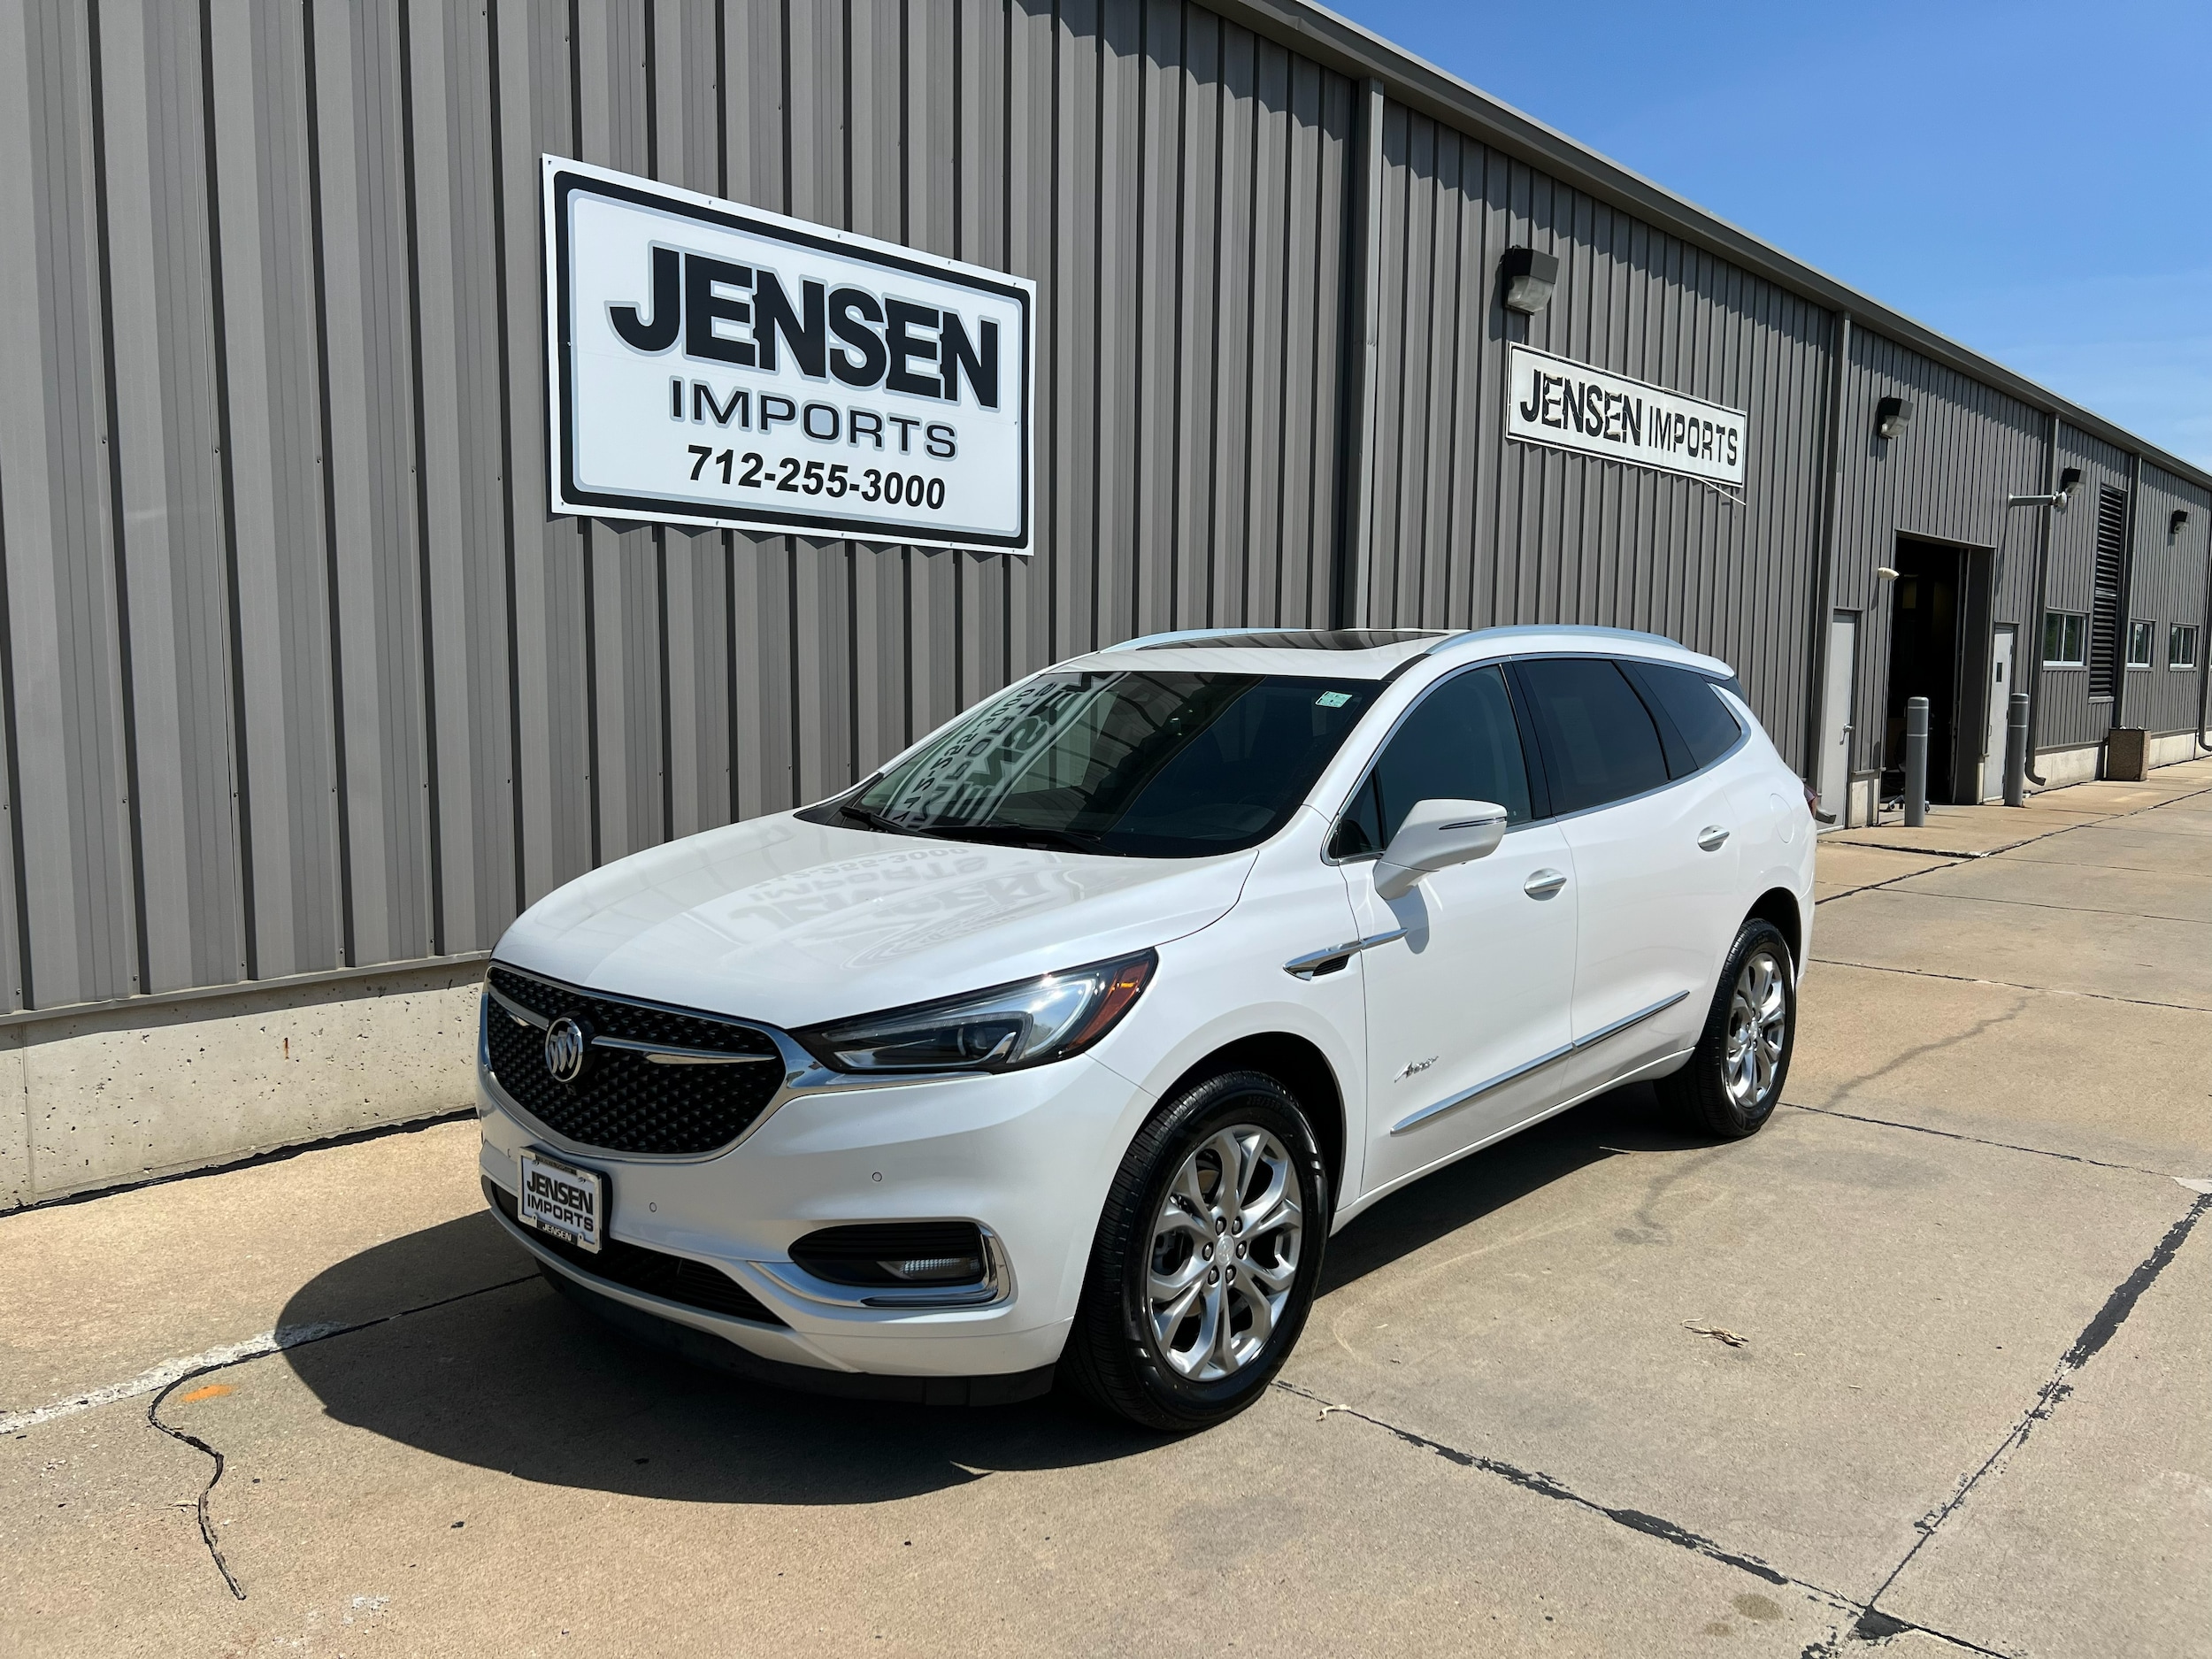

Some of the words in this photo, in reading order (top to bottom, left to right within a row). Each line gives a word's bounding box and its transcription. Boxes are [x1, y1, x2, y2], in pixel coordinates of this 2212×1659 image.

[606, 242, 1001, 411] JENSEN
[671, 377, 956, 460] IMPORTS
[1519, 368, 1642, 447] JENSEN
[1648, 405, 1739, 466] IMPORTS
[687, 444, 947, 510] 712-255-3000
[526, 1170, 595, 1216] JENSEN
[527, 1193, 595, 1233] IMPORTS
[541, 1223, 573, 1242] JENSEN
